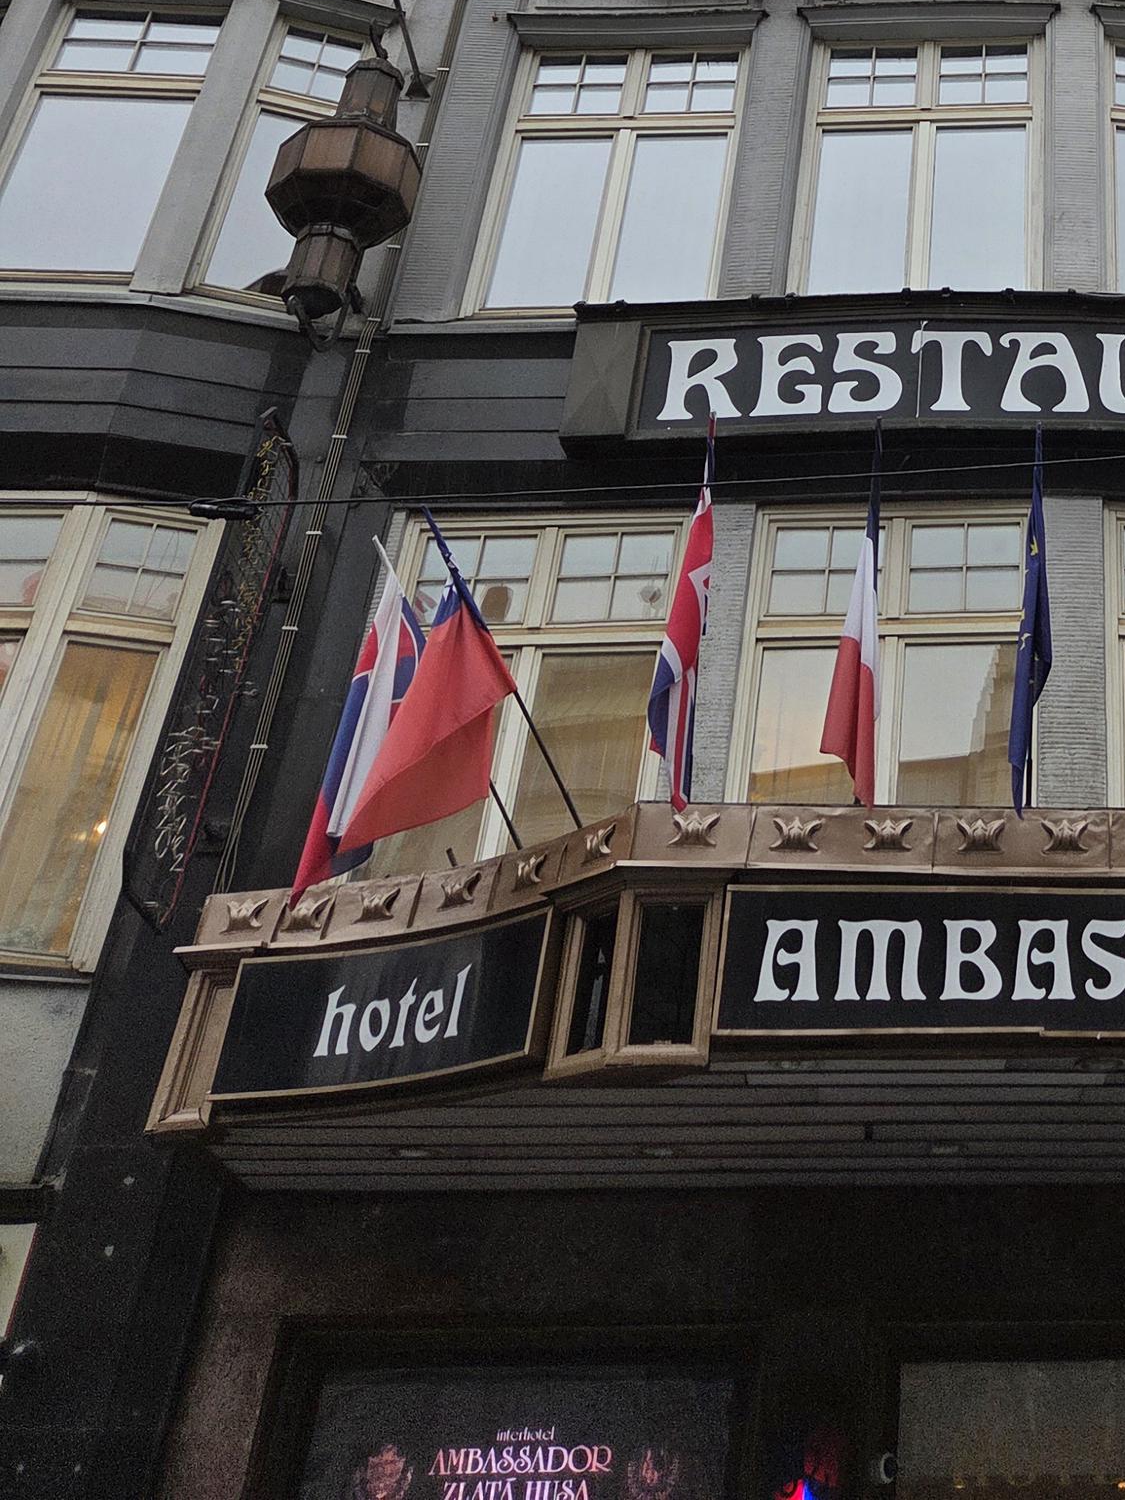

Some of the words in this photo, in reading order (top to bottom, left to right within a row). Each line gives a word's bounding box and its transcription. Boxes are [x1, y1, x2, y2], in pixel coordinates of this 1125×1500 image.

[312, 962, 473, 1059] hotel
[495, 1425, 556, 1442] interhotel
[427, 1444, 614, 1476] AMBASSADOR
[442, 1477, 518, 1500] ZLATÁ
[524, 1479, 590, 1500] HUSA
